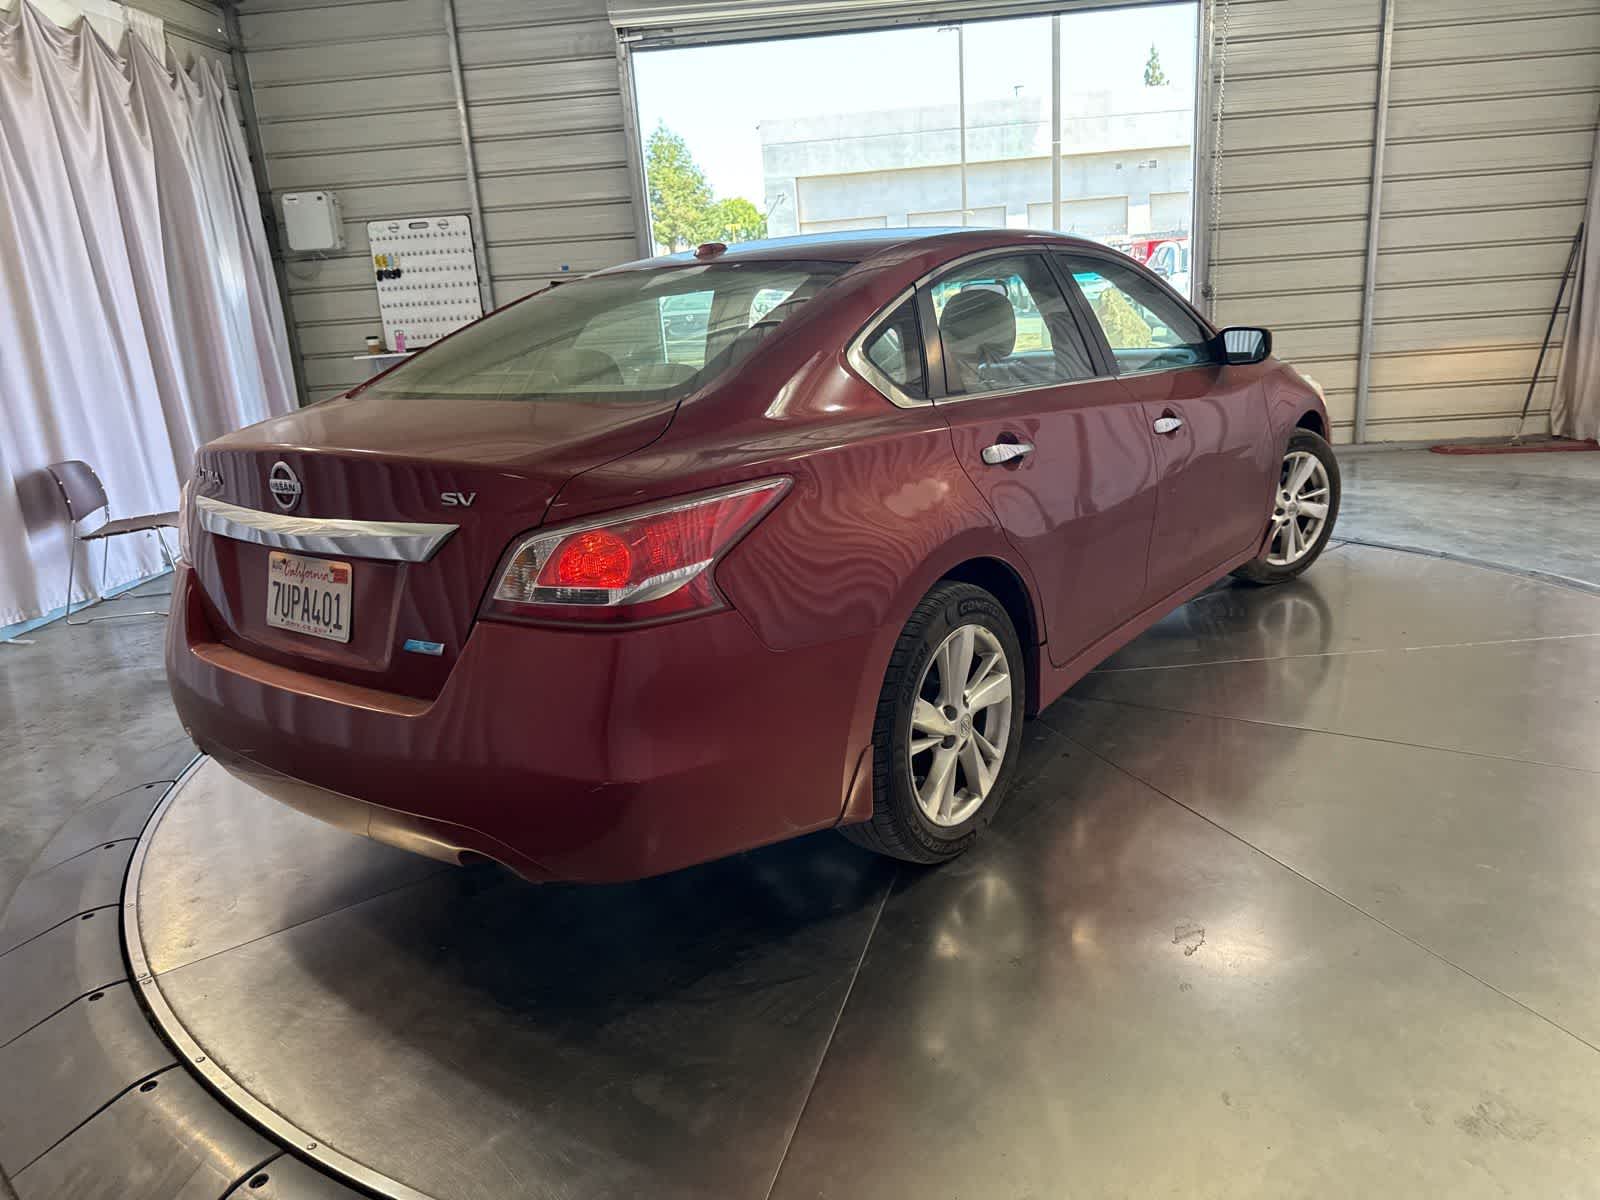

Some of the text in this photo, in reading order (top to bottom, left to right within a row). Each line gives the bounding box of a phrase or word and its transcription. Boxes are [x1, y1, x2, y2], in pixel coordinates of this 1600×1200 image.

[441, 492, 476, 506] SV
[284, 559, 328, 583] California
[273, 581, 342, 630] 7UPA401
